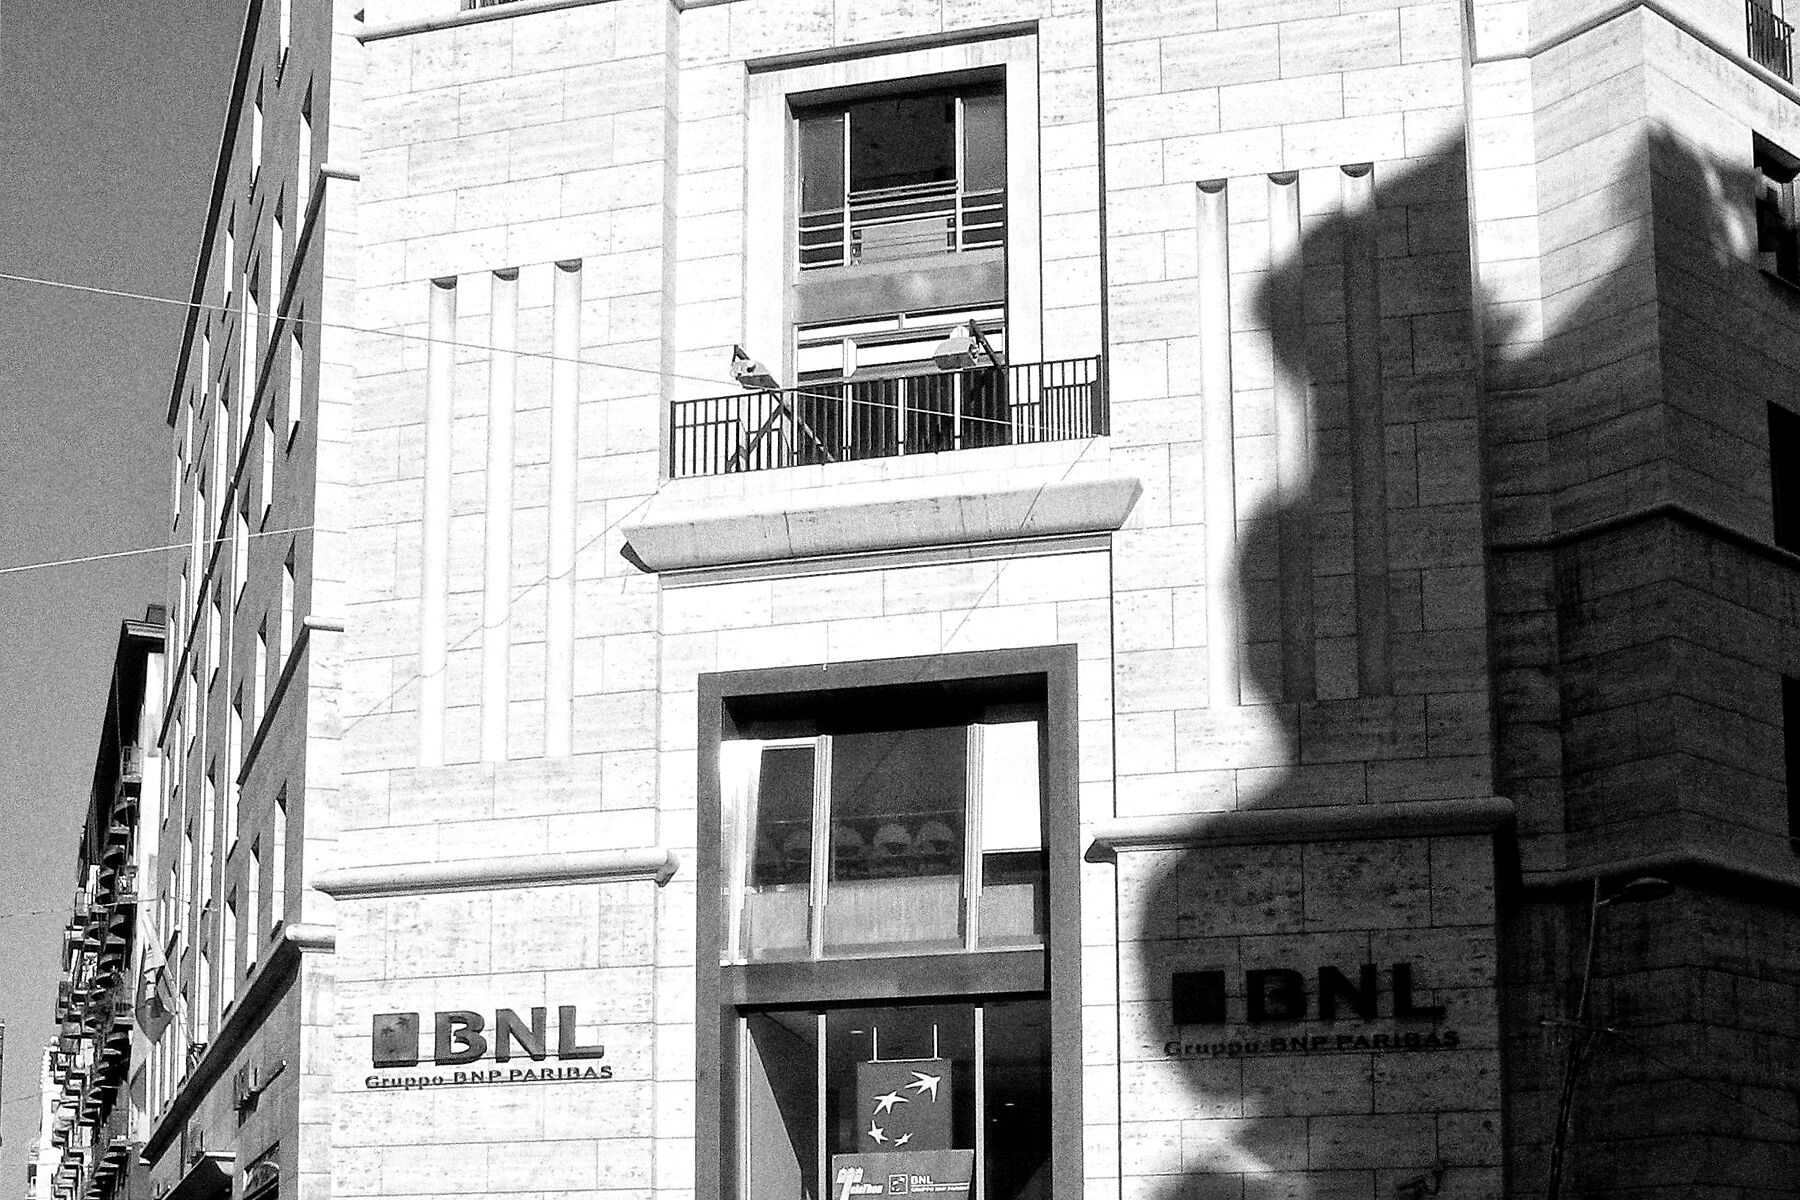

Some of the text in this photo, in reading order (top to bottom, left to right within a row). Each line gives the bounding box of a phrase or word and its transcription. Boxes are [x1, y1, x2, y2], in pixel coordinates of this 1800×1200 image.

[1246, 962, 1446, 1021] BNL
[435, 1005, 604, 1066] BNL
[1163, 1031, 1460, 1060] Gruppo BNP PARIBAS
[365, 1065, 614, 1090] Gruppo BNP PARIBAS
[910, 1175, 934, 1185] BNL
